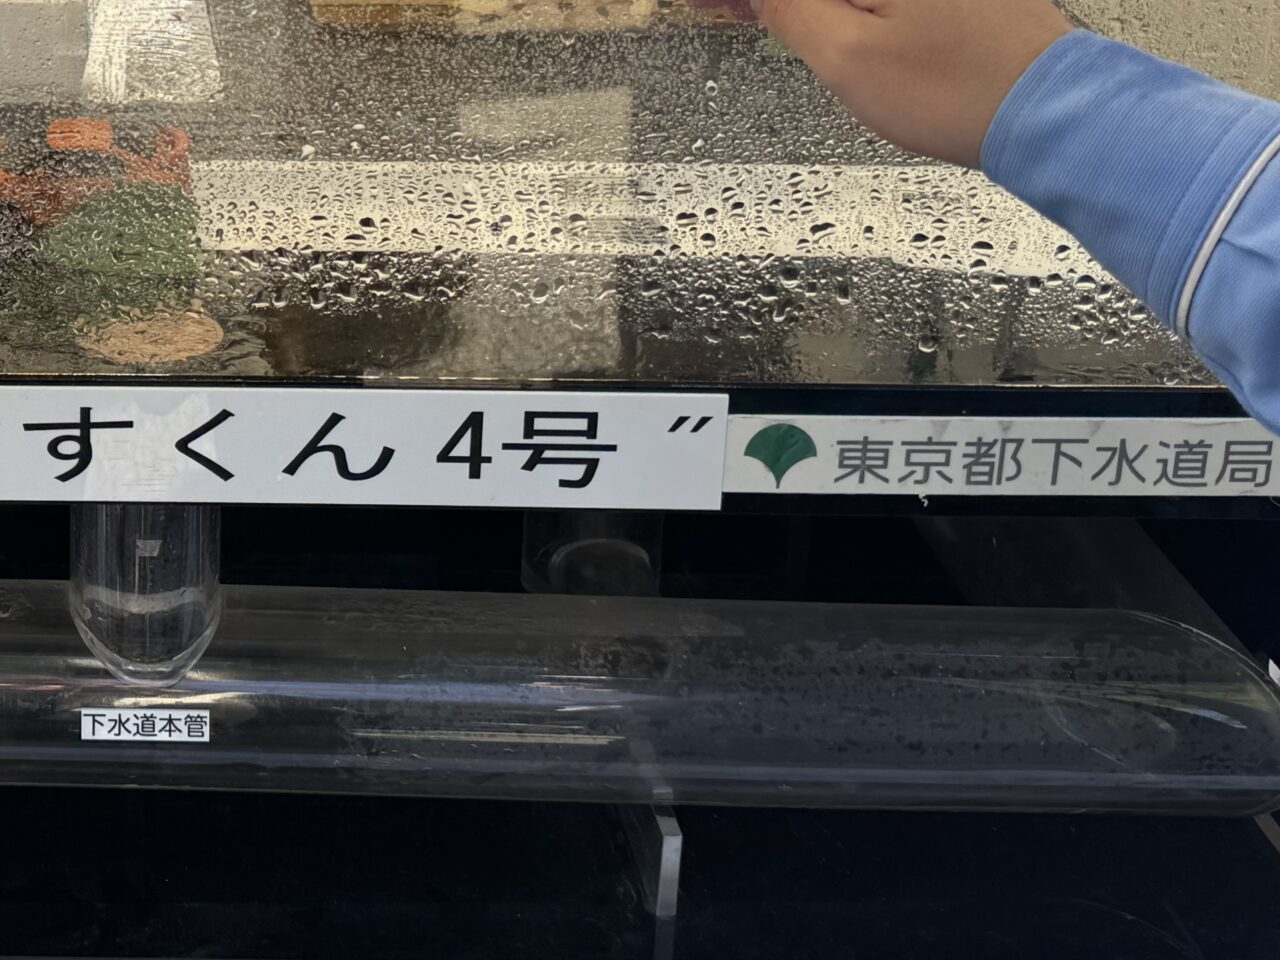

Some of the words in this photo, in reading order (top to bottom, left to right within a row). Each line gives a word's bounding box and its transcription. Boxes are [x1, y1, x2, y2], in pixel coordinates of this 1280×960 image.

[833, 435, 1274, 489] 東京都下水道局
[82, 713, 208, 738] 下水道本管
